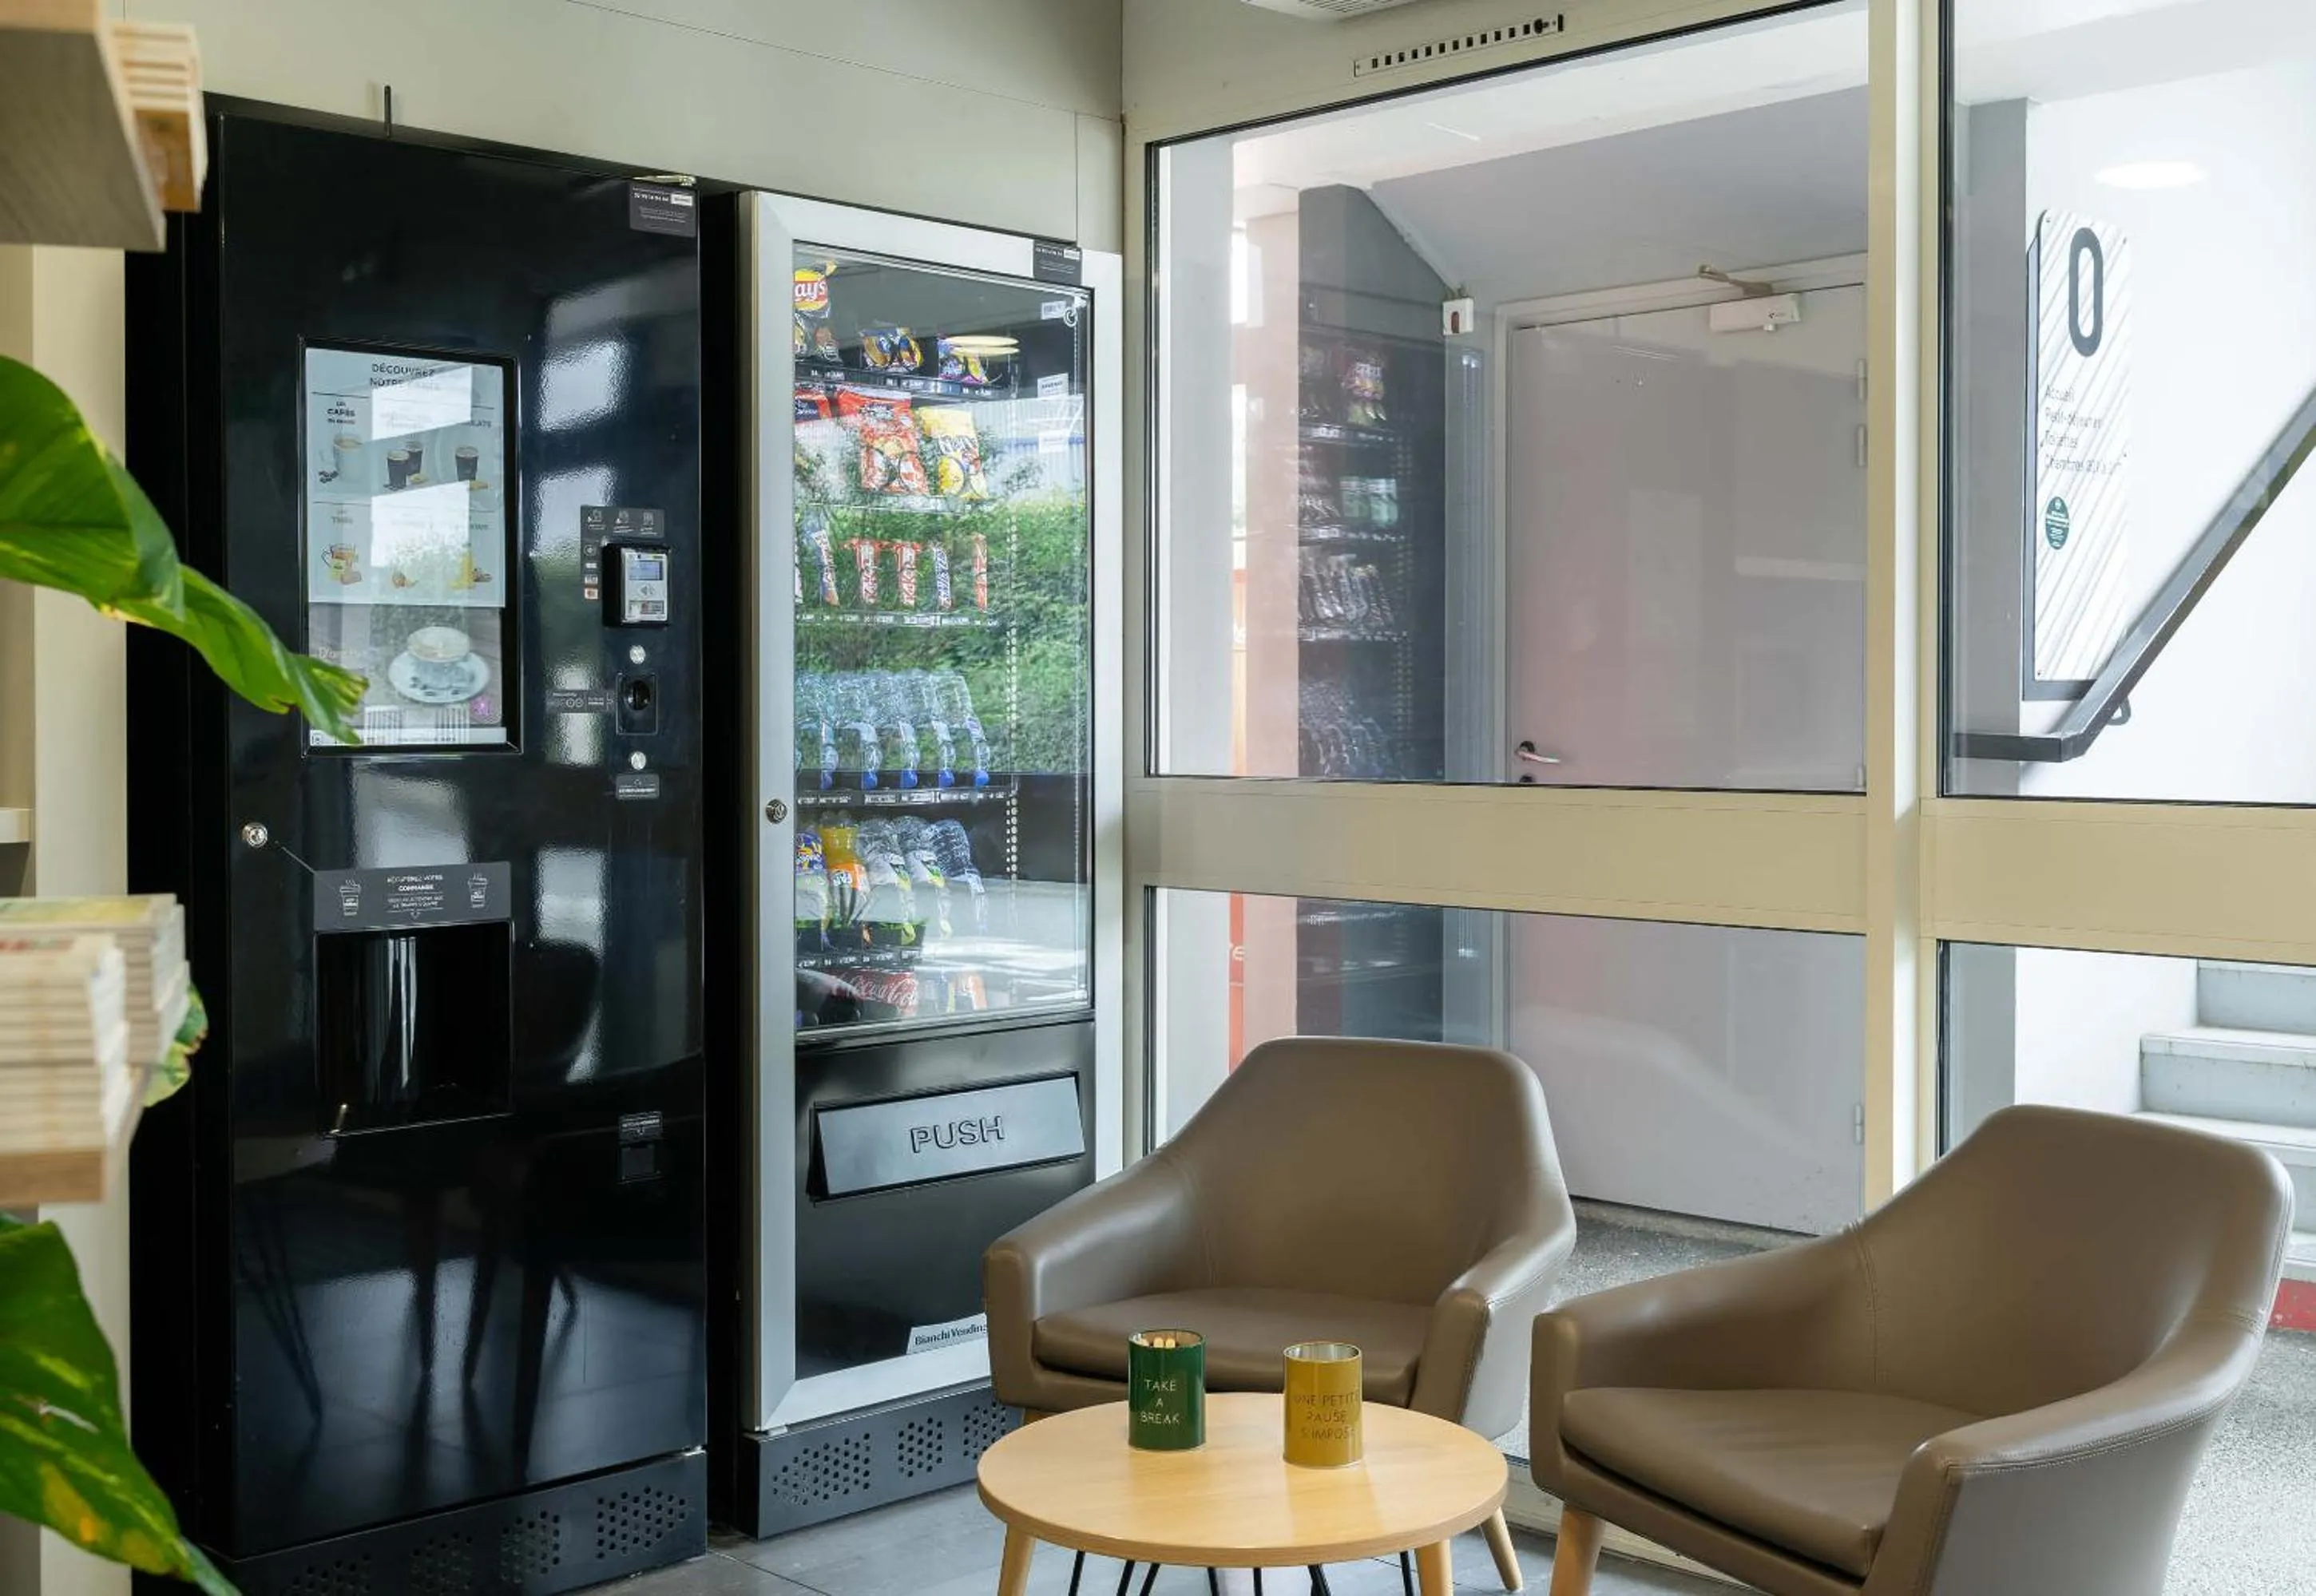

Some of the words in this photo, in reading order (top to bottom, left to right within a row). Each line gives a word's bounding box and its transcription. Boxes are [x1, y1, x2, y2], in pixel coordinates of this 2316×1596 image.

[794, 279, 827, 302] ay's
[2068, 227, 2104, 357] 0
[910, 1115, 1005, 1154] PUSH
[1144, 1379, 1176, 1392] TAKE
[1156, 1397, 1164, 1408] A
[1140, 1411, 1180, 1425] BREAK
[1307, 1408, 1347, 1423] PAUSE
